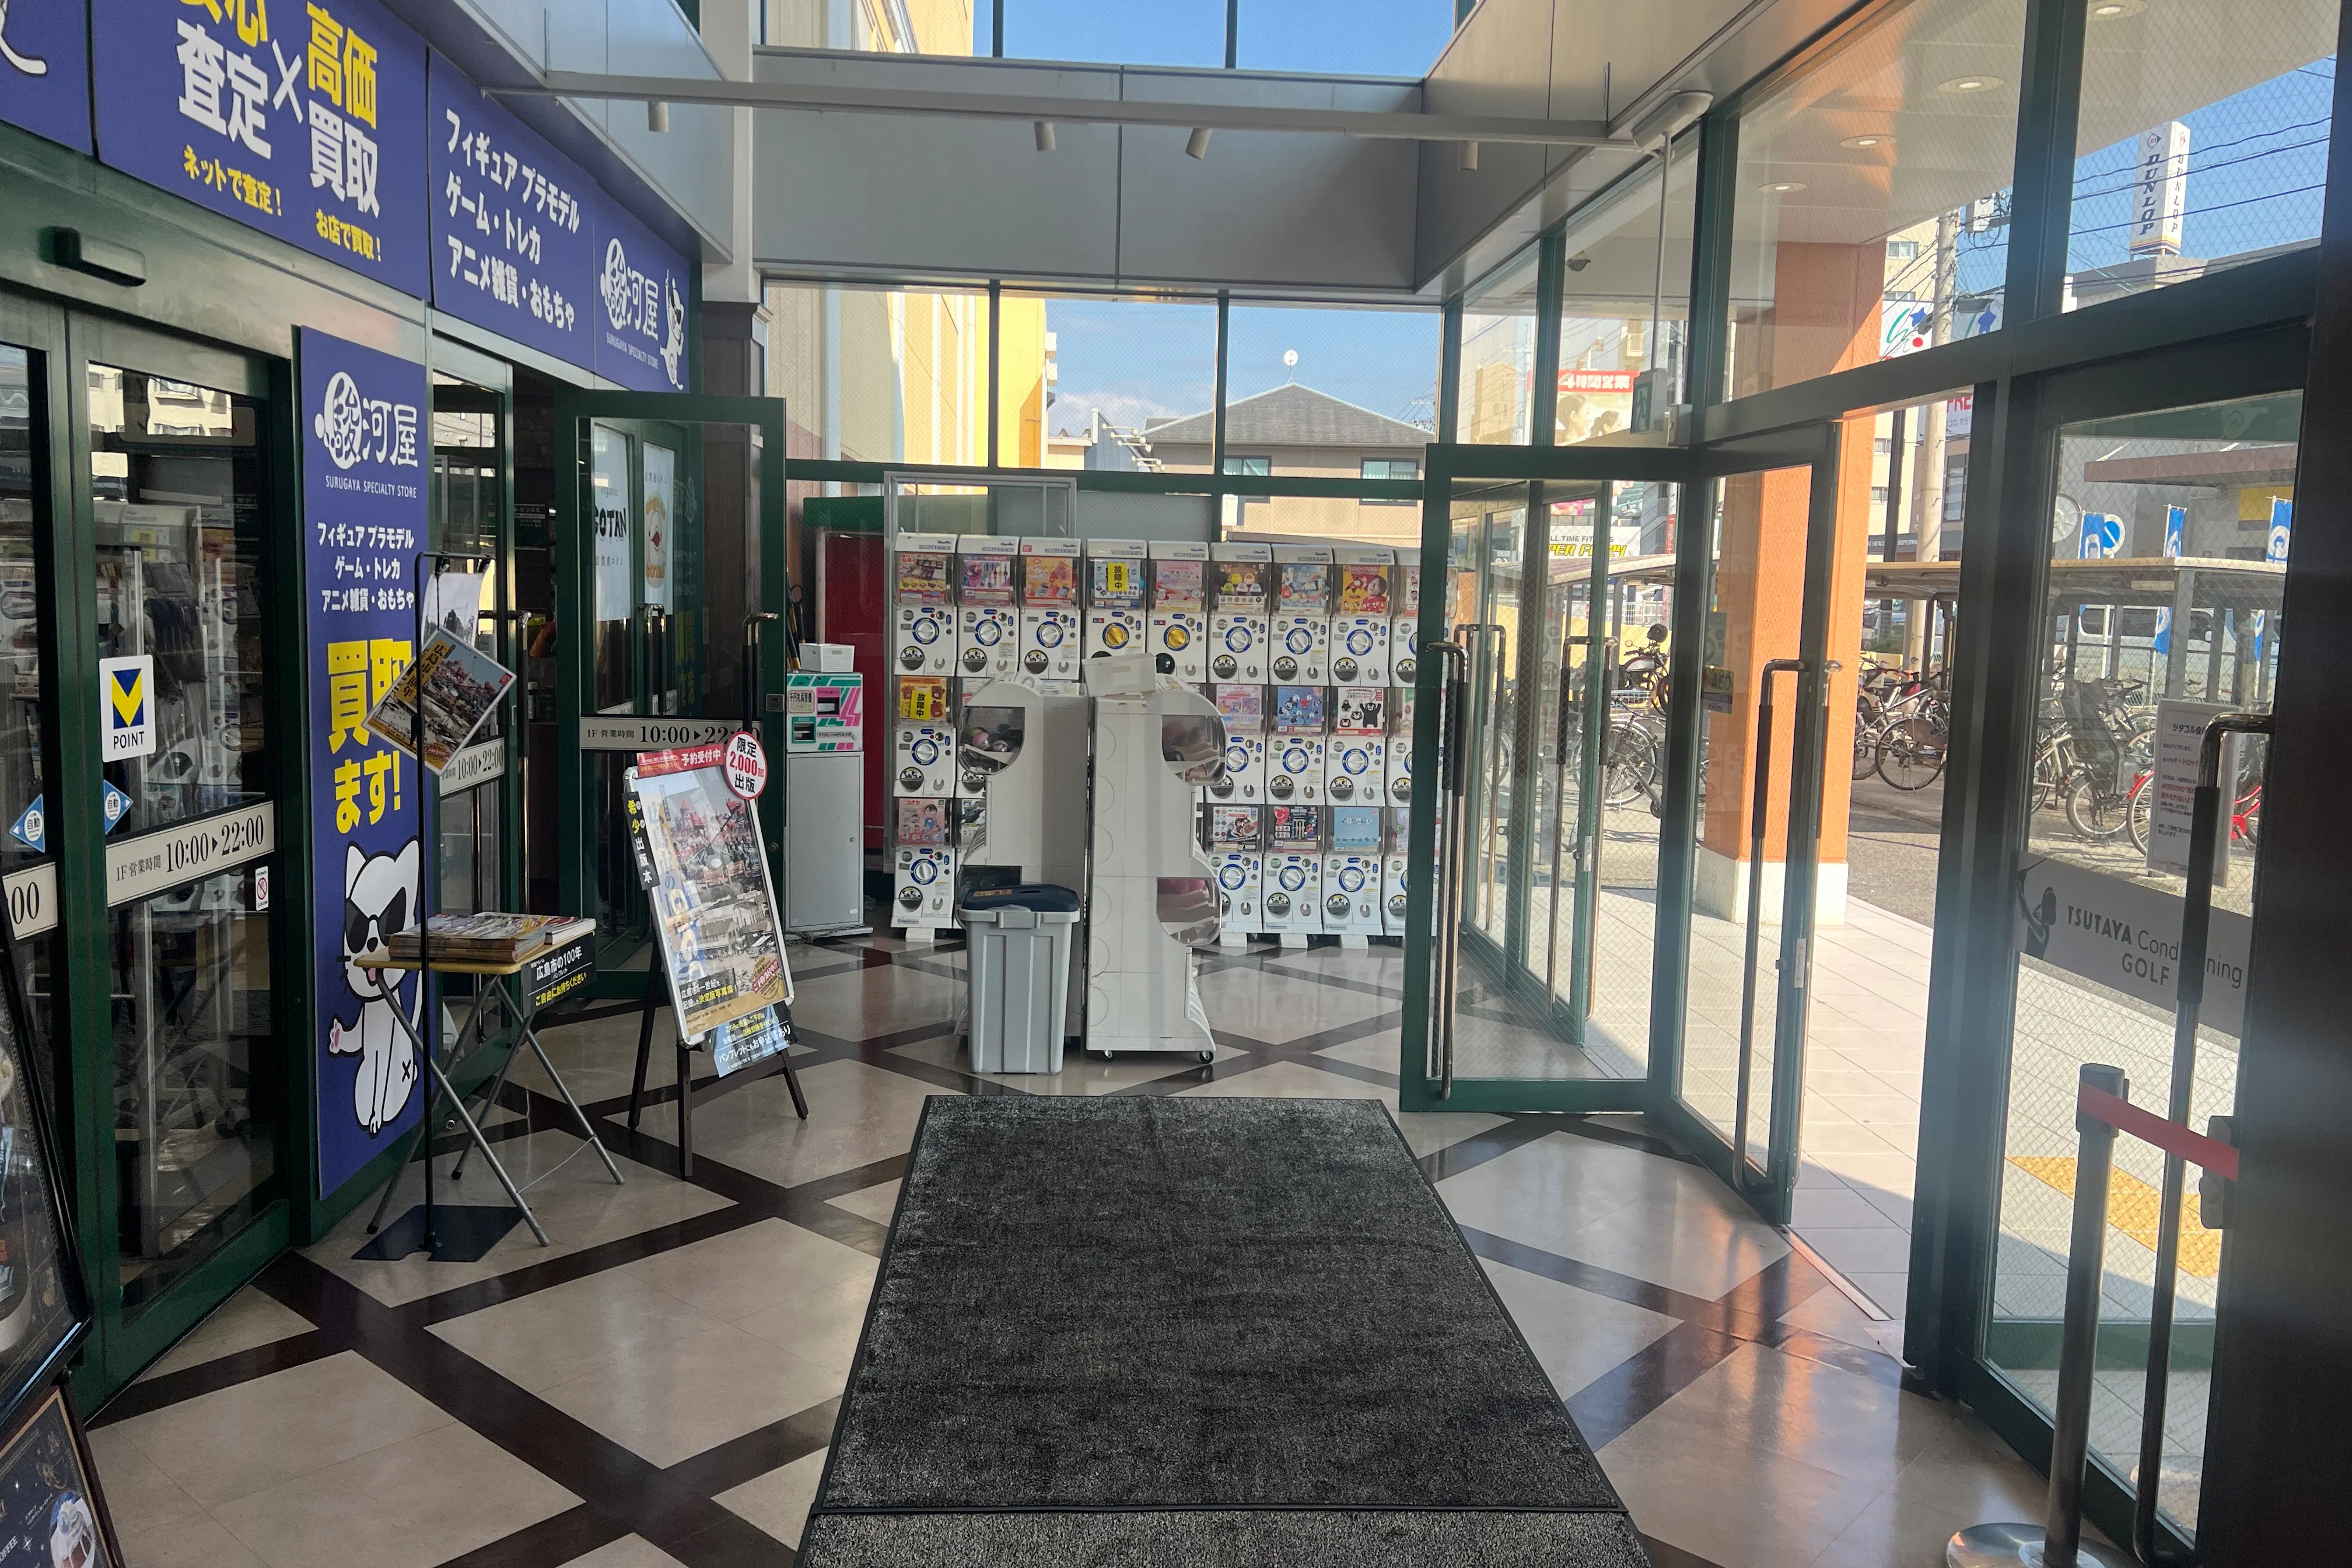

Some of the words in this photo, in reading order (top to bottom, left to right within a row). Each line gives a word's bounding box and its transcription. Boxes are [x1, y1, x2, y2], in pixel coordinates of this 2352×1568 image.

[306, 2, 377, 130] 高価
[176, 18, 271, 159] 査定
[308, 100, 380, 218] 買取
[446, 108, 517, 192] フィギュア
[522, 163, 580, 234] プラモデル
[184, 145, 283, 215] ネットで査定!
[2139, 153, 2160, 236] DUNLOP
[2171, 154, 2185, 232] DUNLOP
[445, 170, 541, 265] ゲーム・トレカ
[316, 209, 382, 262] お店で買取!
[448, 235, 575, 332] アニメ雑貨・おもちゃ
[606, 331, 627, 354] SURUGAYA
[628, 343, 648, 364] SPECIALTY
[647, 353, 659, 371] STORE
[1559, 373, 1631, 389] 4時間営業
[326, 475, 361, 493] SURUGAYA
[363, 478, 395, 496] SPECIALTY
[397, 484, 417, 499] STORE
[317, 523, 365, 548] フィギュア
[368, 526, 415, 550] プラモデル
[334, 555, 401, 580] ゲーム・トレカ
[321, 587, 415, 612] アニメ雑貨・おもちゃ
[113, 731, 145, 750] POINT
[586, 729, 597, 738] 1F
[600, 729, 635, 738] 営業時間
[640, 726, 690, 744] 10:00
[737, 736, 757, 758] 限定
[457, 754, 478, 780] 10:00
[482, 745, 504, 772] 22:00
[681, 748, 722, 766] 予約受付中
[334, 750, 401, 834] ます!
[735, 774, 755, 794] 出版
[117, 866, 127, 882] 1F
[129, 853, 162, 877] 営業時間
[166, 832, 209, 873] 10:00
[221, 814, 264, 857] 22:00
[536, 946, 582, 981] 広島市の100年
[2066, 905, 2132, 946] TSUTAYA
[2137, 930, 2242, 989] Condning
[2121, 953, 2171, 986] GOLF
[536, 972, 587, 1006] ご自由にお持ちください
[0, 1536, 19, 1562] OFFEE
